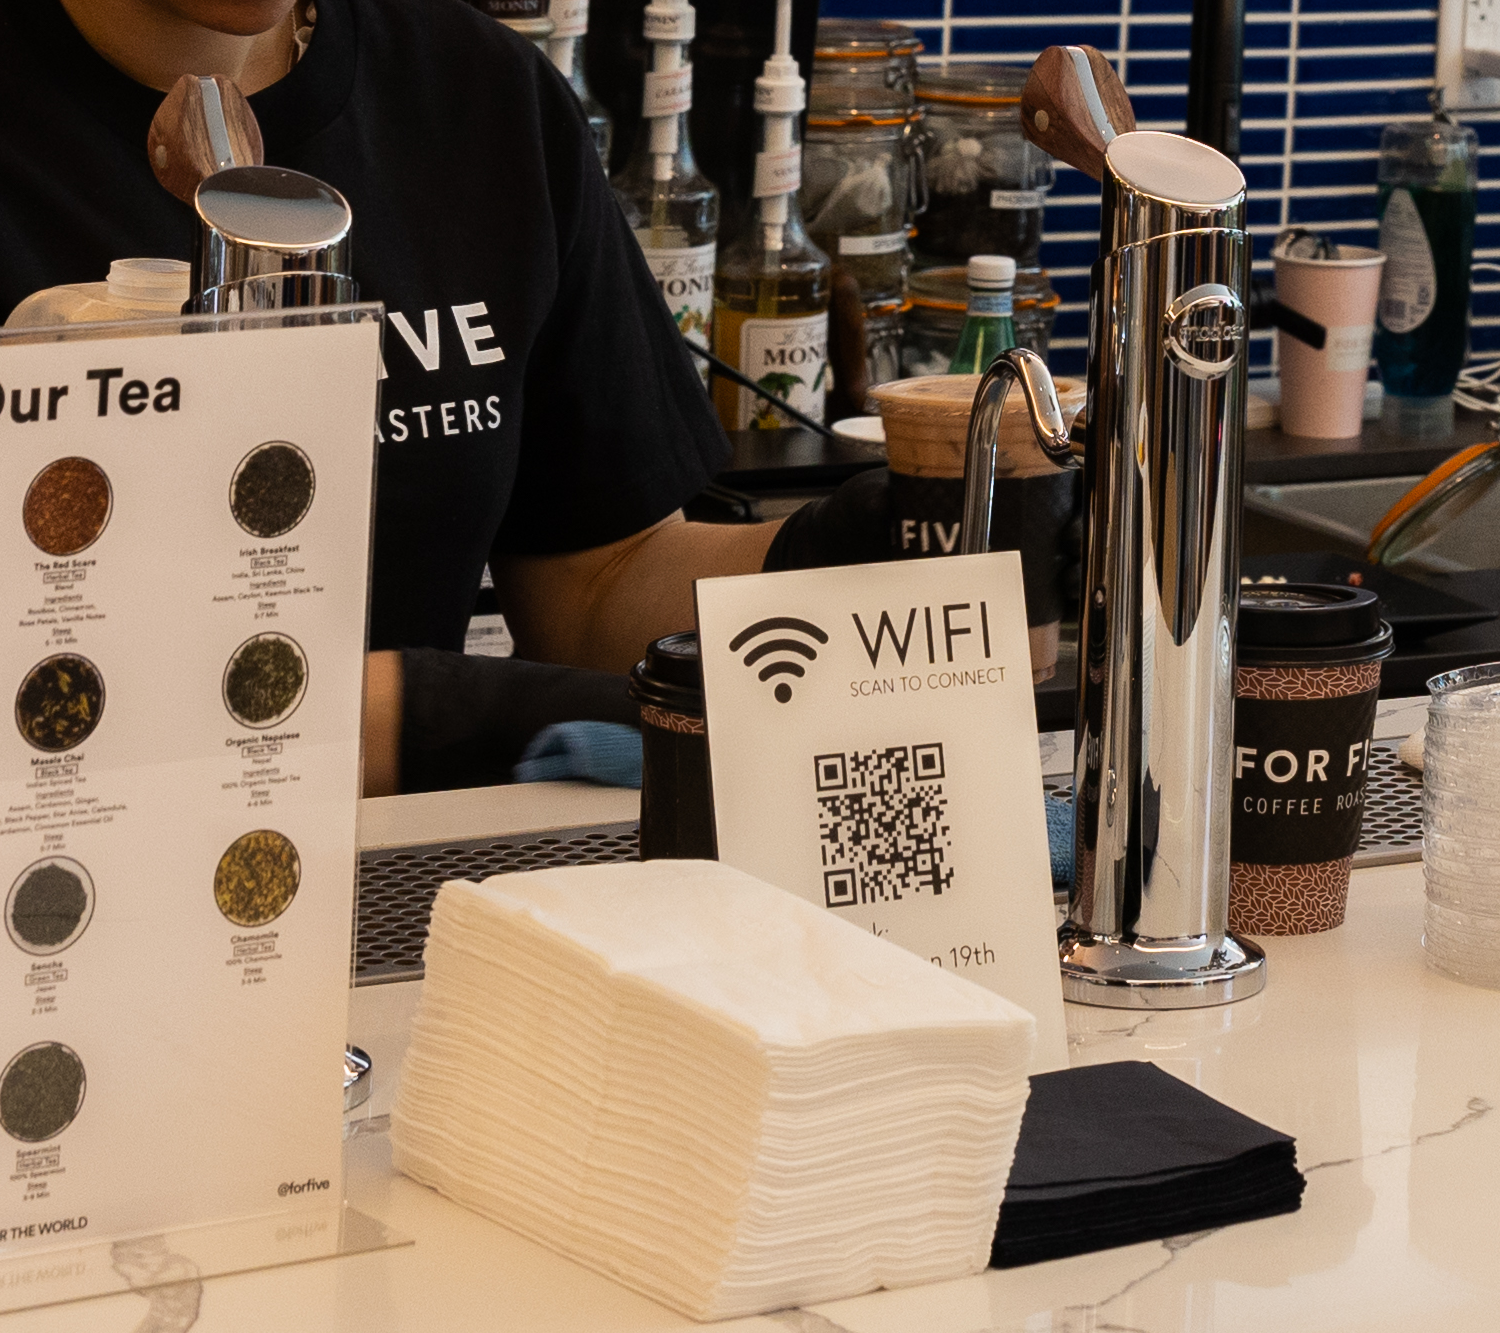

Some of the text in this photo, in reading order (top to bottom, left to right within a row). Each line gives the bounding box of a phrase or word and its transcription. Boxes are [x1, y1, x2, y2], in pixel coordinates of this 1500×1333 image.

[378, 301, 506, 380] VE
[85, 367, 181, 418] Tea
[375, 395, 501, 444] STERS
[239, 544, 300, 558] Irish Breakfast
[851, 601, 991, 670] WIFI
[849, 666, 1007, 698] SCAN TO CONNECT
[1235, 745, 1330, 783] FOR
[1243, 796, 1323, 815] COFFEE
[948, 942, 996, 968] 19th
[276, 1177, 331, 1199] @forfive
[10, 1223, 35, 1241] THE
[38, 1215, 88, 1239] WORLD
